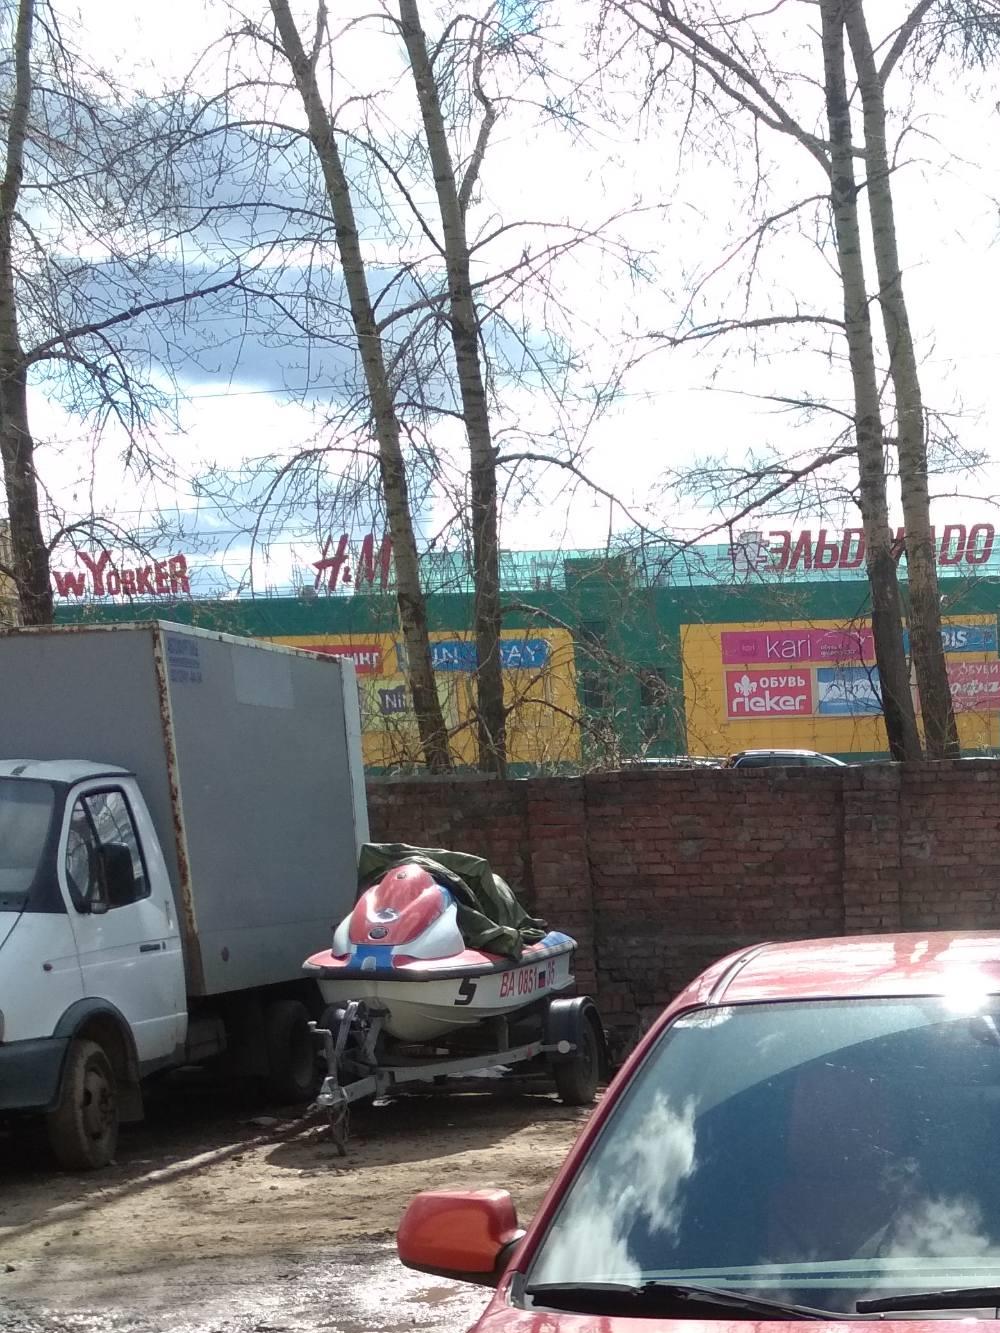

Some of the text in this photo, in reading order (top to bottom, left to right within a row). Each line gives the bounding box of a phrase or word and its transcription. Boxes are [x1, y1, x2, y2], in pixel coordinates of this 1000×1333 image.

[312, 533, 393, 592] H&M
[766, 634, 811, 658] kari
[759, 675, 806, 689] ОБУВЬ
[732, 690, 807, 713] rieker
[517, 966, 538, 996] 0851
